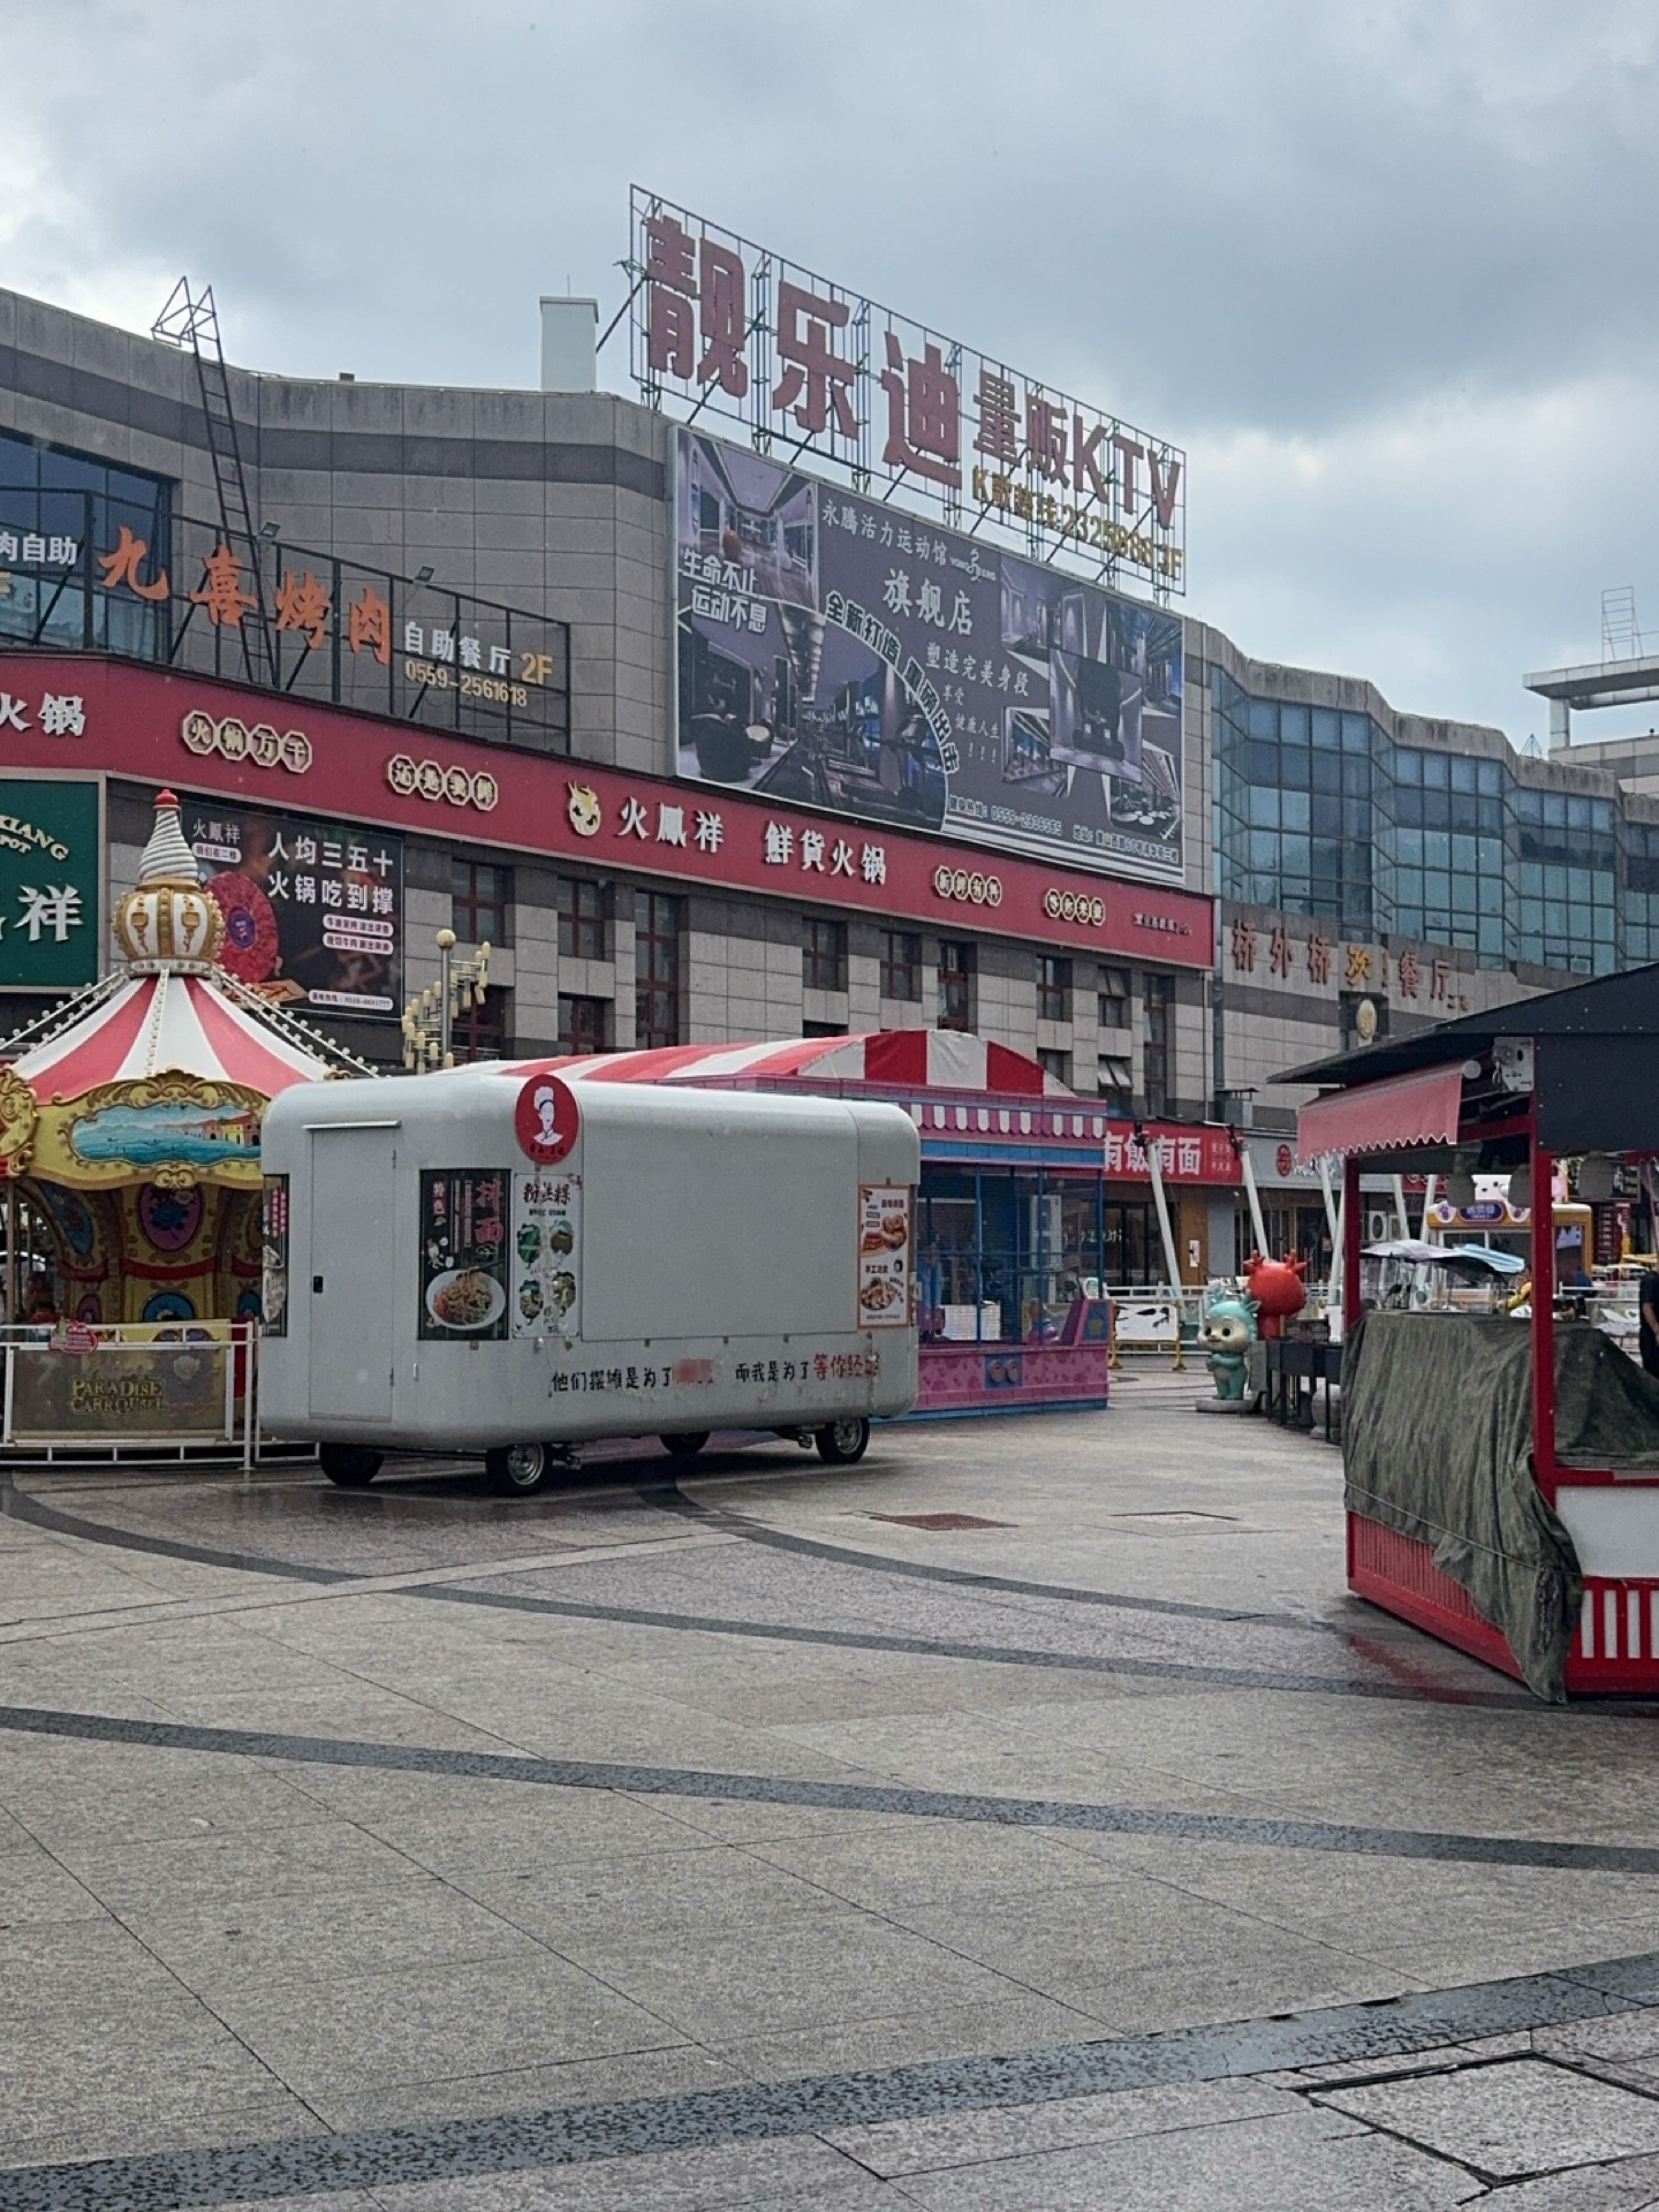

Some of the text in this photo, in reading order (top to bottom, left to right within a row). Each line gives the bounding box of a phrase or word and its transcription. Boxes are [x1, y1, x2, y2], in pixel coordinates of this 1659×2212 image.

[822, 499, 947, 566] 永腾活力运动馆
[99, 525, 391, 665] 九喜烤肉
[682, 549, 757, 594] 生命不止
[692, 585, 767, 632] 运动不息
[883, 568, 972, 635] 旗舰店
[405, 621, 552, 685] 自助餐厅 2F
[926, 641, 1028, 696] 塑造完美身段
[405, 660, 527, 707] 0559-2561618
[943, 684, 964, 705] 享受
[268, 832, 394, 877] 人均三五十
[268, 870, 394, 915] 火锅吃到撑
[71, 1395, 167, 1414] CARROUSEL
[72, 1379, 163, 1397] PARADISE
